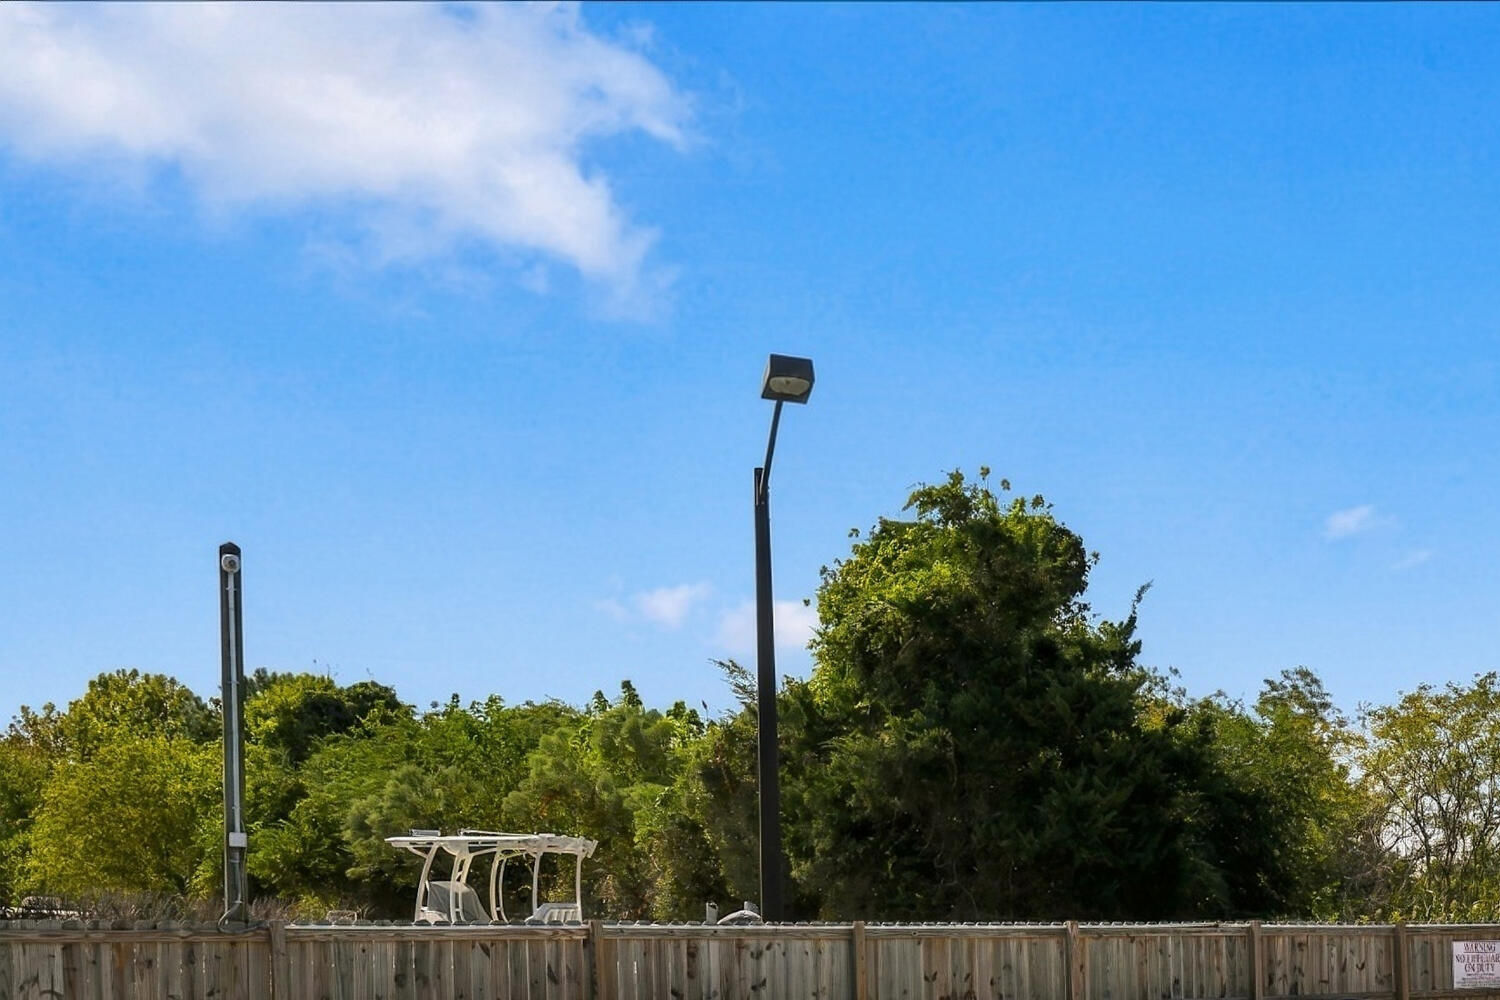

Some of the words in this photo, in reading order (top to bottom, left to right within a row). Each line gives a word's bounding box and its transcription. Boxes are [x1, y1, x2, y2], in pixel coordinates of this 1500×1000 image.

[1463, 942, 1496, 952] WARNING
[1455, 953, 1466, 963] NO
[1464, 963, 1475, 973] ON
[1476, 963, 1496, 973] DUTY
